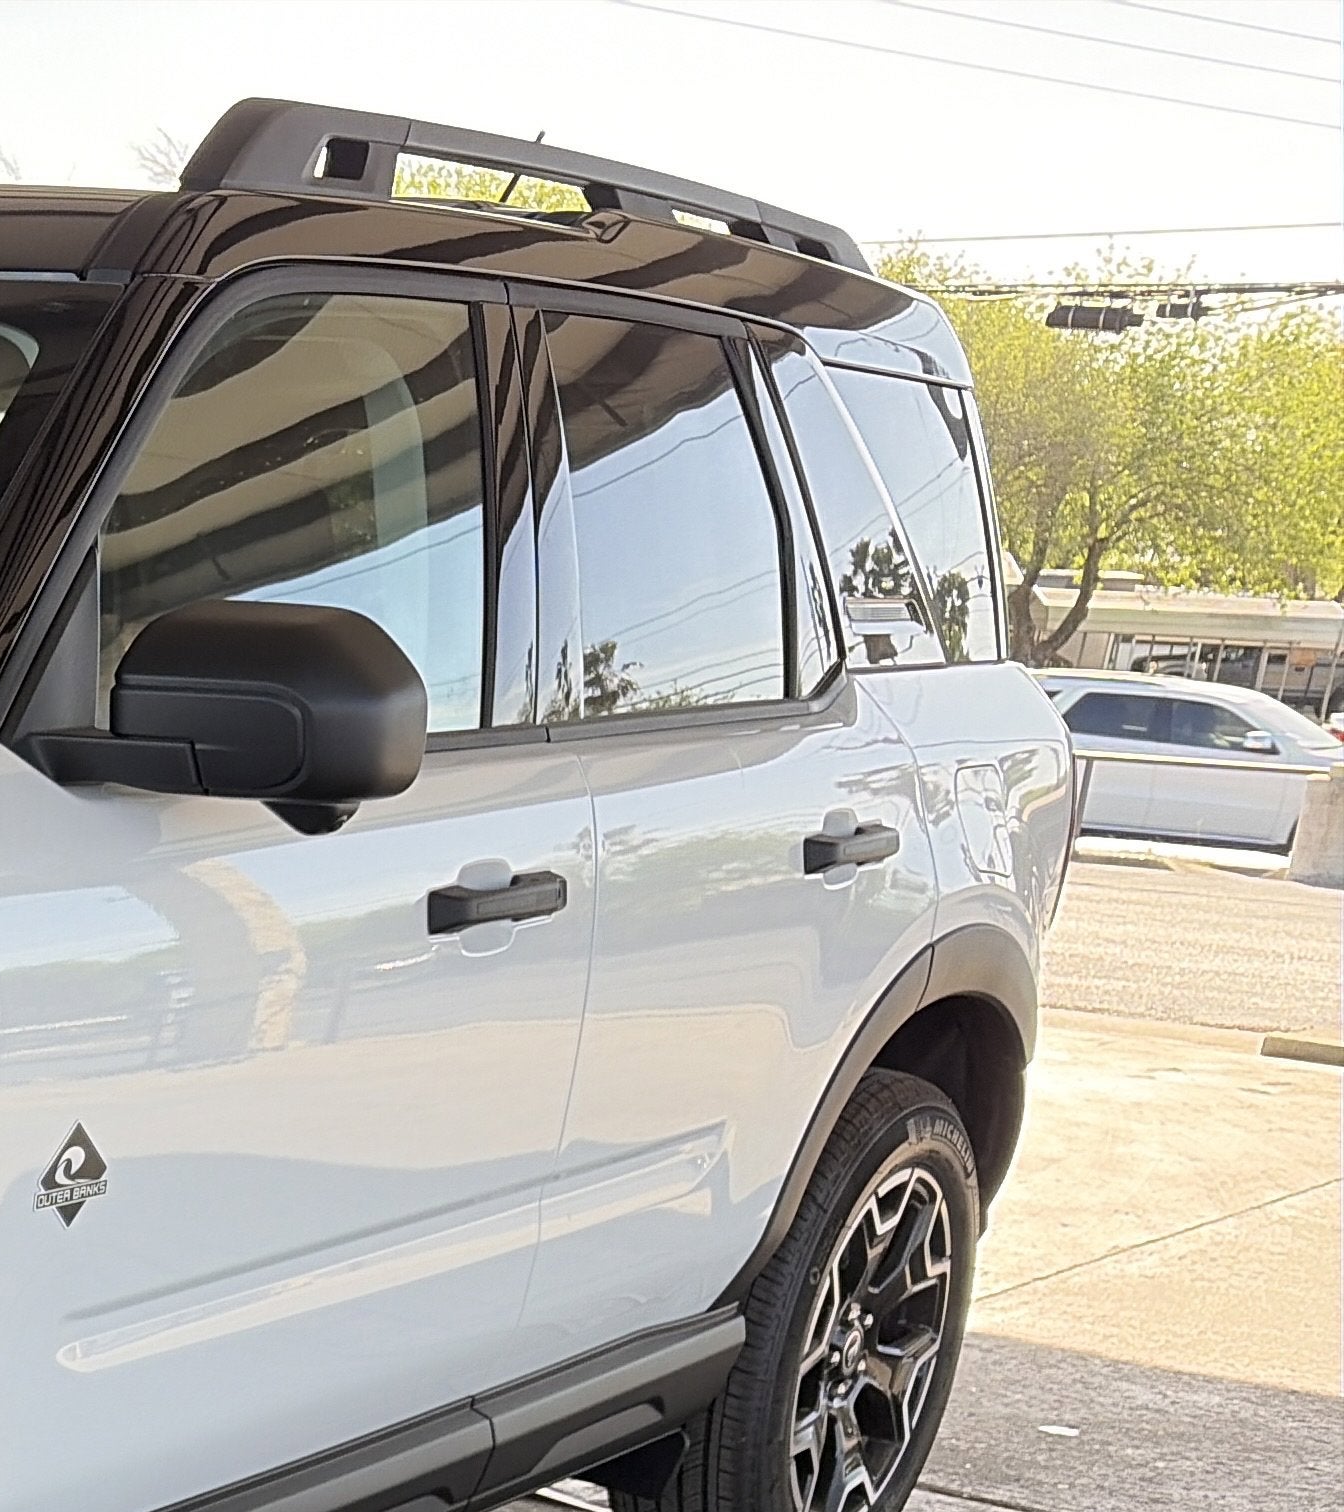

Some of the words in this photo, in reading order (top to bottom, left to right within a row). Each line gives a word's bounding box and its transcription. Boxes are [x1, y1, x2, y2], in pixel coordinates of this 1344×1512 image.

[933, 1118, 976, 1174] MICHELIN
[37, 1189, 71, 1208] OUTER
[72, 1181, 107, 1200] BANKS
